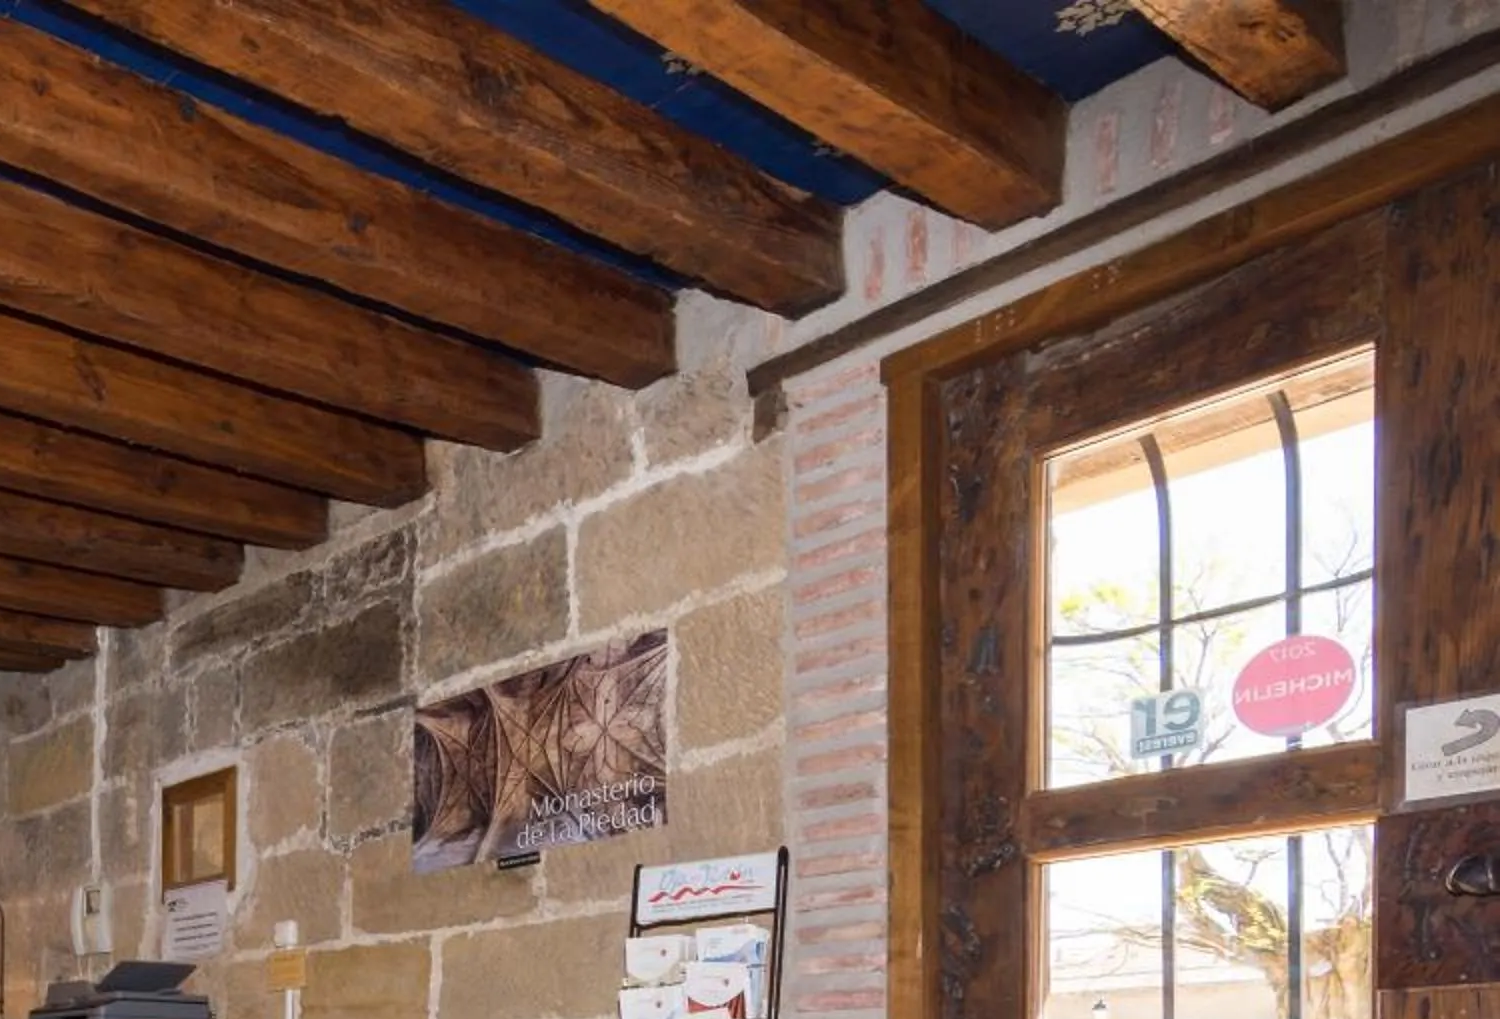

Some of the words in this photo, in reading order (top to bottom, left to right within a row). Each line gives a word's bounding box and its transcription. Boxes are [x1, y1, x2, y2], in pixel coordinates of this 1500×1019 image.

[529, 772, 656, 820] Monasterio
[515, 823, 544, 849] de
[550, 818, 574, 843] la
[579, 796, 656, 837] Piedad
